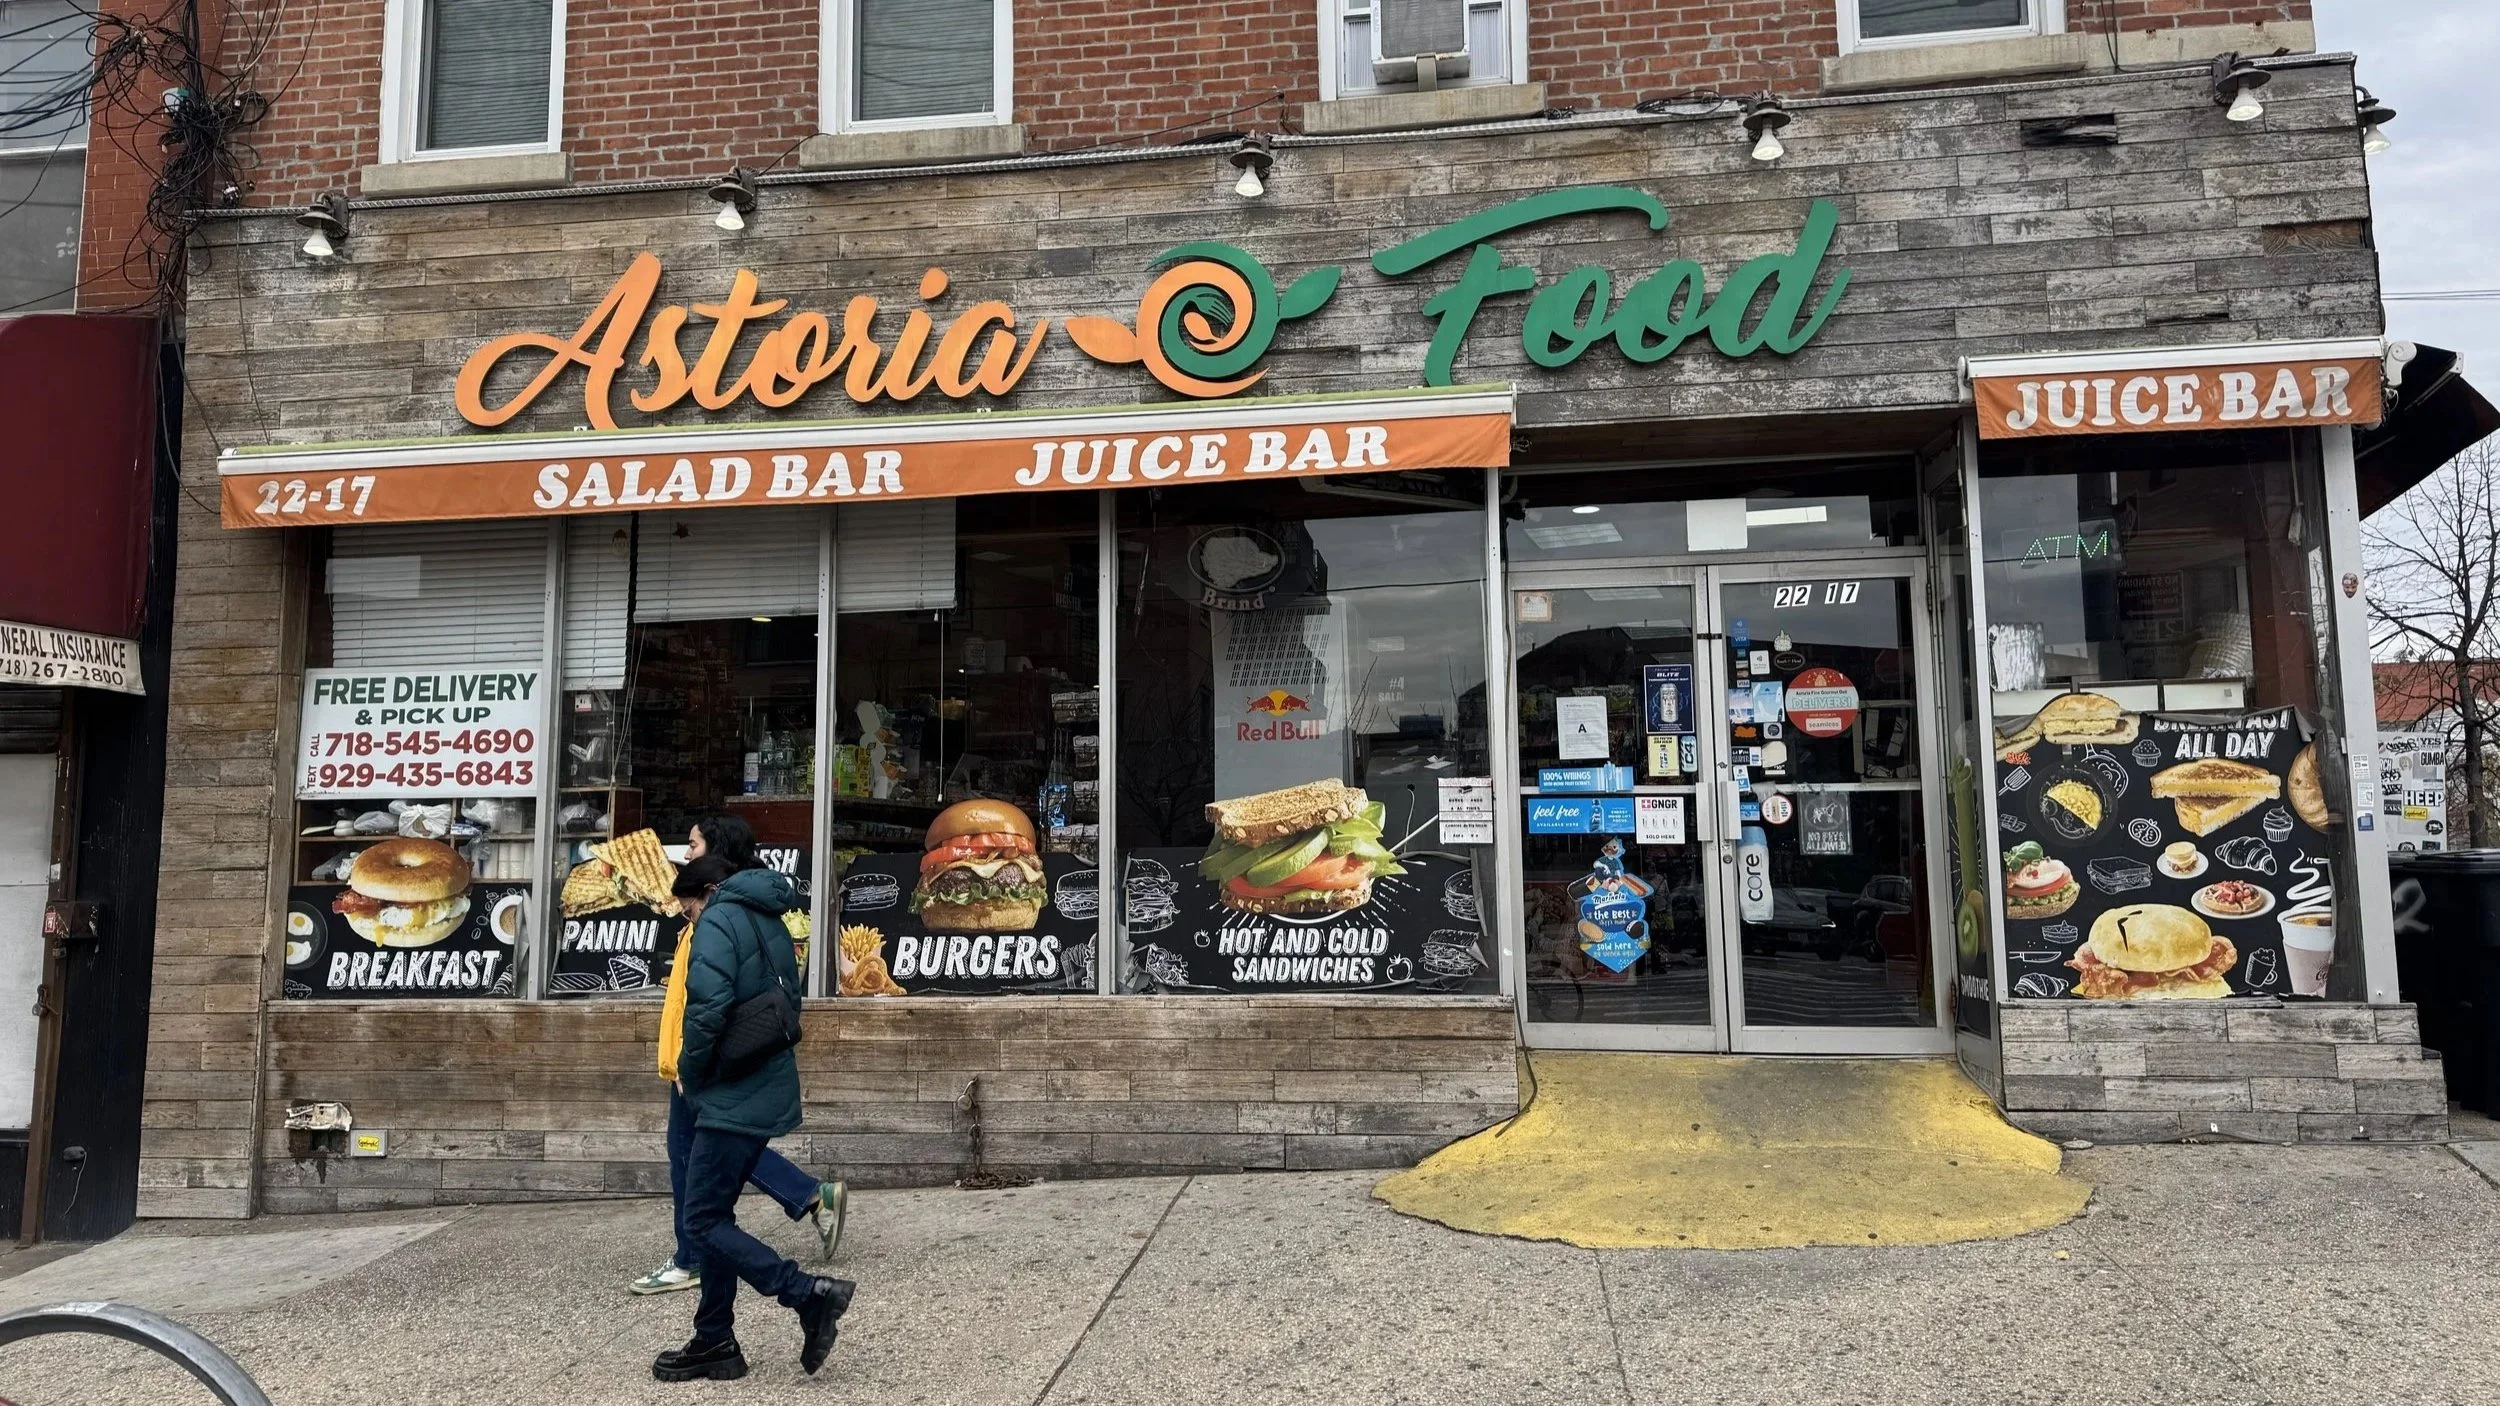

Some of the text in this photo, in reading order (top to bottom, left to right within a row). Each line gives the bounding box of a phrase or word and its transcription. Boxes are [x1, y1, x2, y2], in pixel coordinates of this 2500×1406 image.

[454, 185, 1852, 432] Astoria Food
[2005, 366, 2353, 431] JUICE BAR
[1015, 425, 1390, 487] JUICE BAR
[533, 450, 904, 509] SALAD BAR
[256, 475, 376, 516] 22-17
[2020, 530, 2108, 566] ATM
[1201, 586, 1266, 611] Brand
[1774, 581, 1860, 608] 22 17
[50, 632, 127, 669] INSURANCE
[31, 661, 124, 686] 267-2800
[313, 672, 539, 706] FREE DELIVERY
[1791, 696, 1852, 709] DELIVERS!
[354, 706, 491, 725] & PICK UP
[1578, 723, 1587, 733] A
[324, 727, 535, 757] 718-545-4690
[1237, 720, 1320, 741] Red Bull
[309, 733, 320, 757] CALL
[1684, 743, 1693, 765] C4
[2174, 731, 2274, 758] ALL DAY
[306, 764, 317, 789] TEXT
[318, 760, 534, 789] 929-435-6843
[1543, 772, 1562, 780] 100%
[1533, 804, 1580, 820] feel free
[1651, 799, 1678, 809] GNGR
[1746, 853, 1763, 902] core
[1594, 910, 1609, 920] the
[561, 920, 659, 951] PANINI
[1218, 928, 1388, 955] HOT AND COLD
[1597, 942, 1631, 950] sold here
[327, 951, 503, 989] BREAKFAST
[893, 936, 1061, 977] BURGERS
[1231, 957, 1375, 982] SANDWICHES
